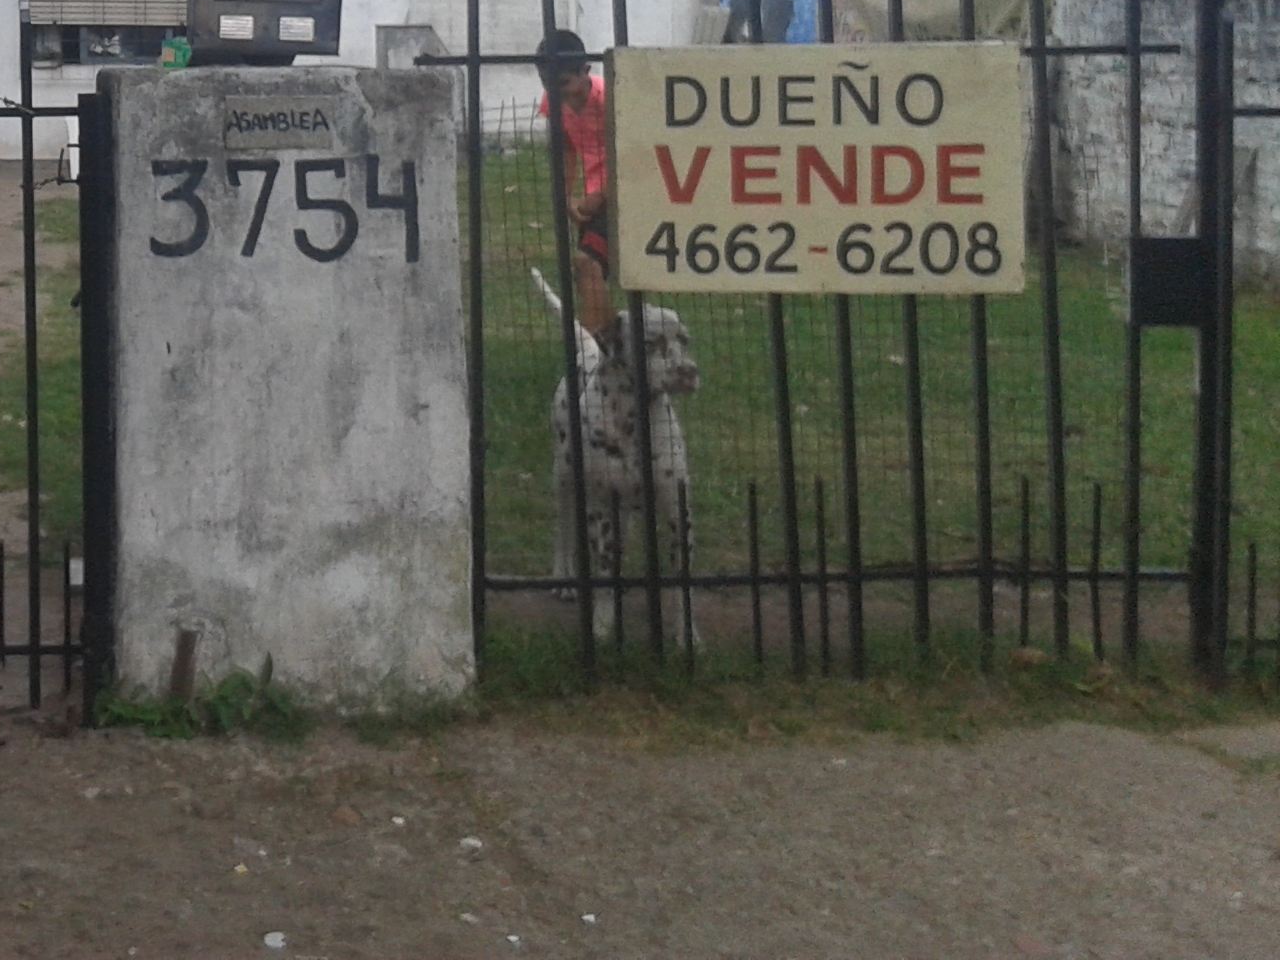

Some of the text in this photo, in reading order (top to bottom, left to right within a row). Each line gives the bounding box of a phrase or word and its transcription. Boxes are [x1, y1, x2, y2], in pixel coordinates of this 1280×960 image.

[226, 109, 330, 134] ASAMBLEA
[665, 60, 944, 127] DUEÑO
[654, 143, 986, 206] VENDE
[150, 153, 420, 264] 3754
[644, 221, 1003, 277] 4662-6208
